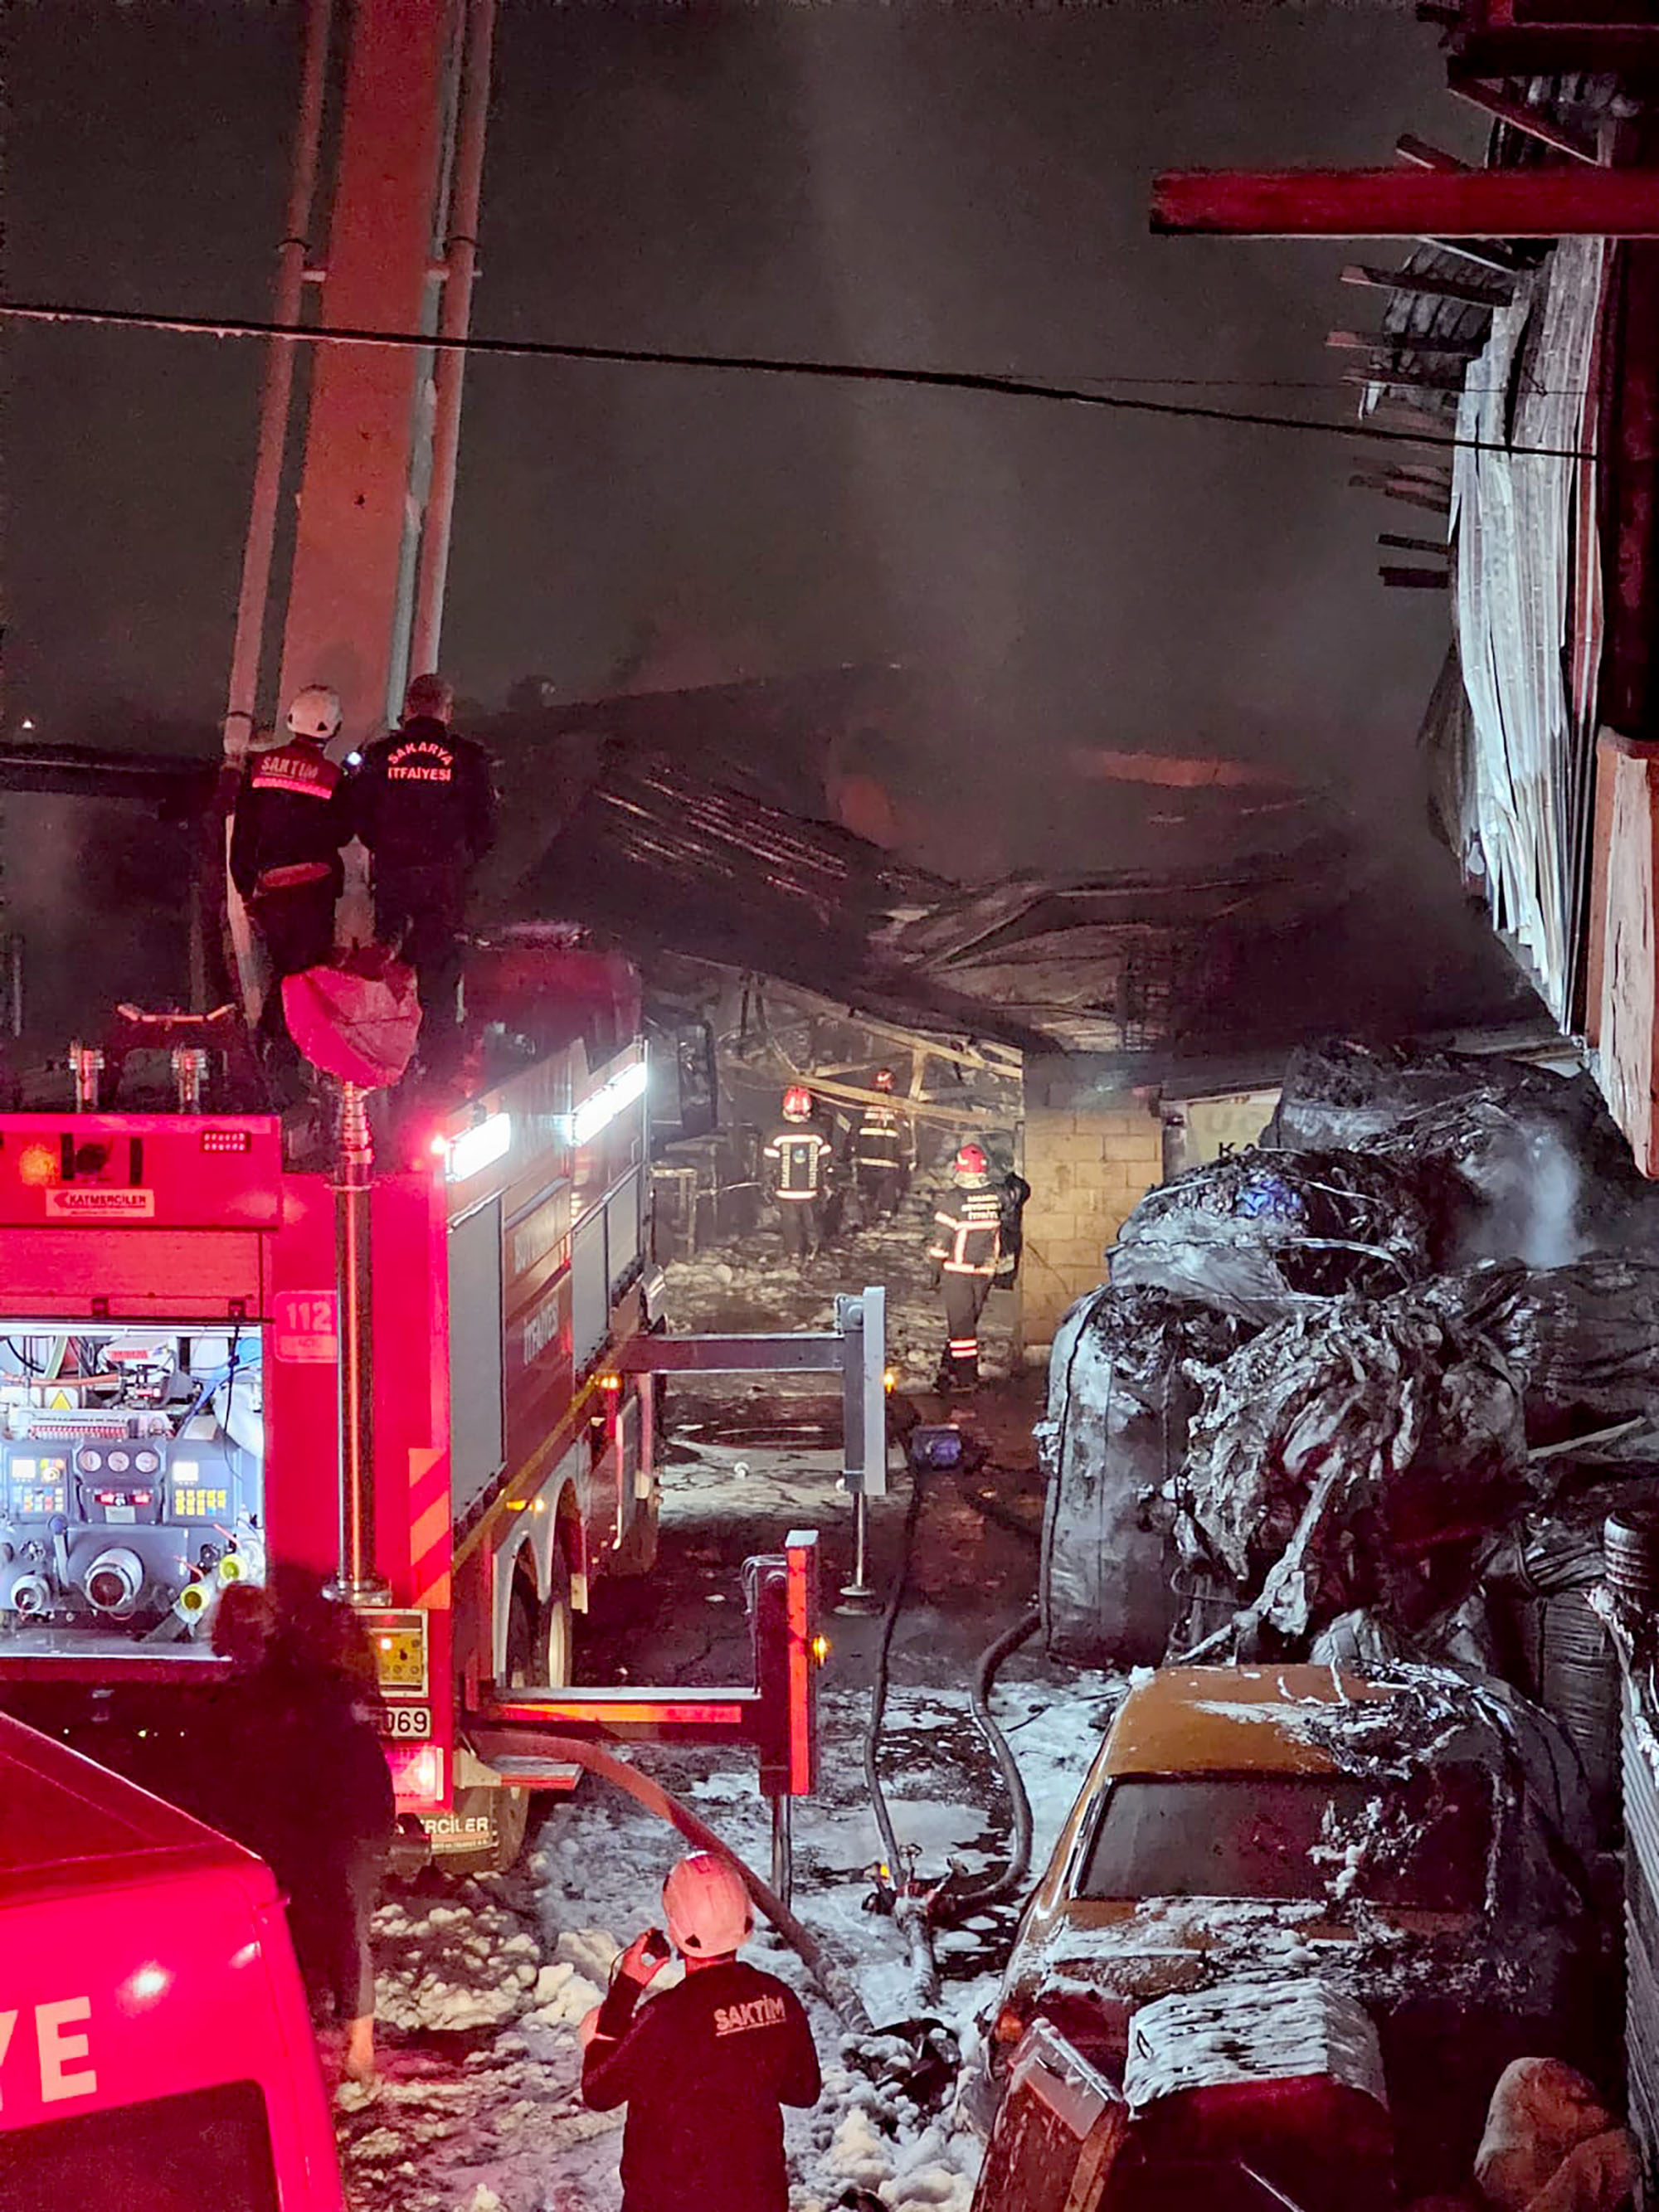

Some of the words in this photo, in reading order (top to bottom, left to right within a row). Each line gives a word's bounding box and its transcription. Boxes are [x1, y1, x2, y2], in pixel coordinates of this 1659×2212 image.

[387, 741, 453, 765] SAKARYA
[286, 1301, 332, 1331] 112
[421, 1814, 489, 1835] RCİLER
